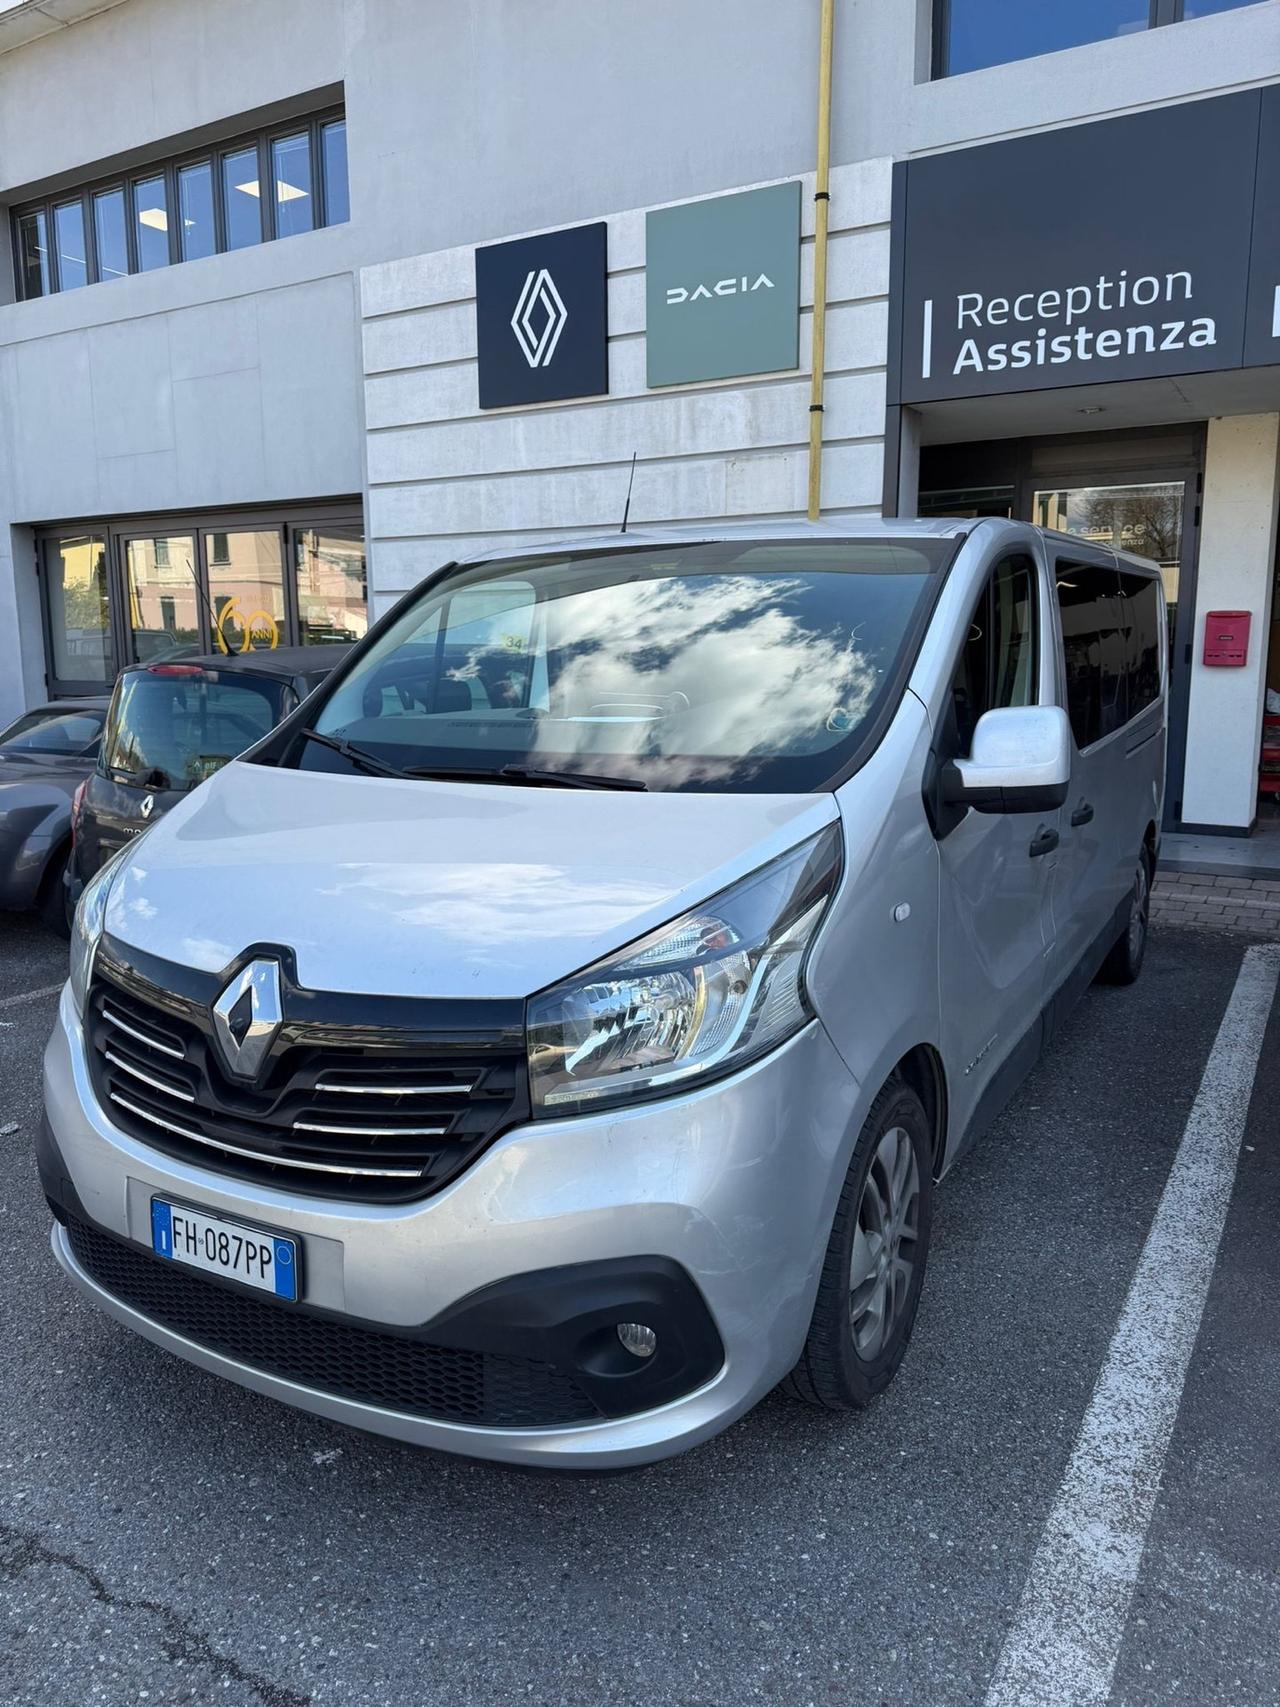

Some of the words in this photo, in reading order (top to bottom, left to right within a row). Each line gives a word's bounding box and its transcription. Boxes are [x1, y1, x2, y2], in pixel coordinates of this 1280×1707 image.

[666, 273, 775, 305] DACIA
[956, 270, 1193, 330] Reception
[952, 316, 1217, 376] Assistenza
